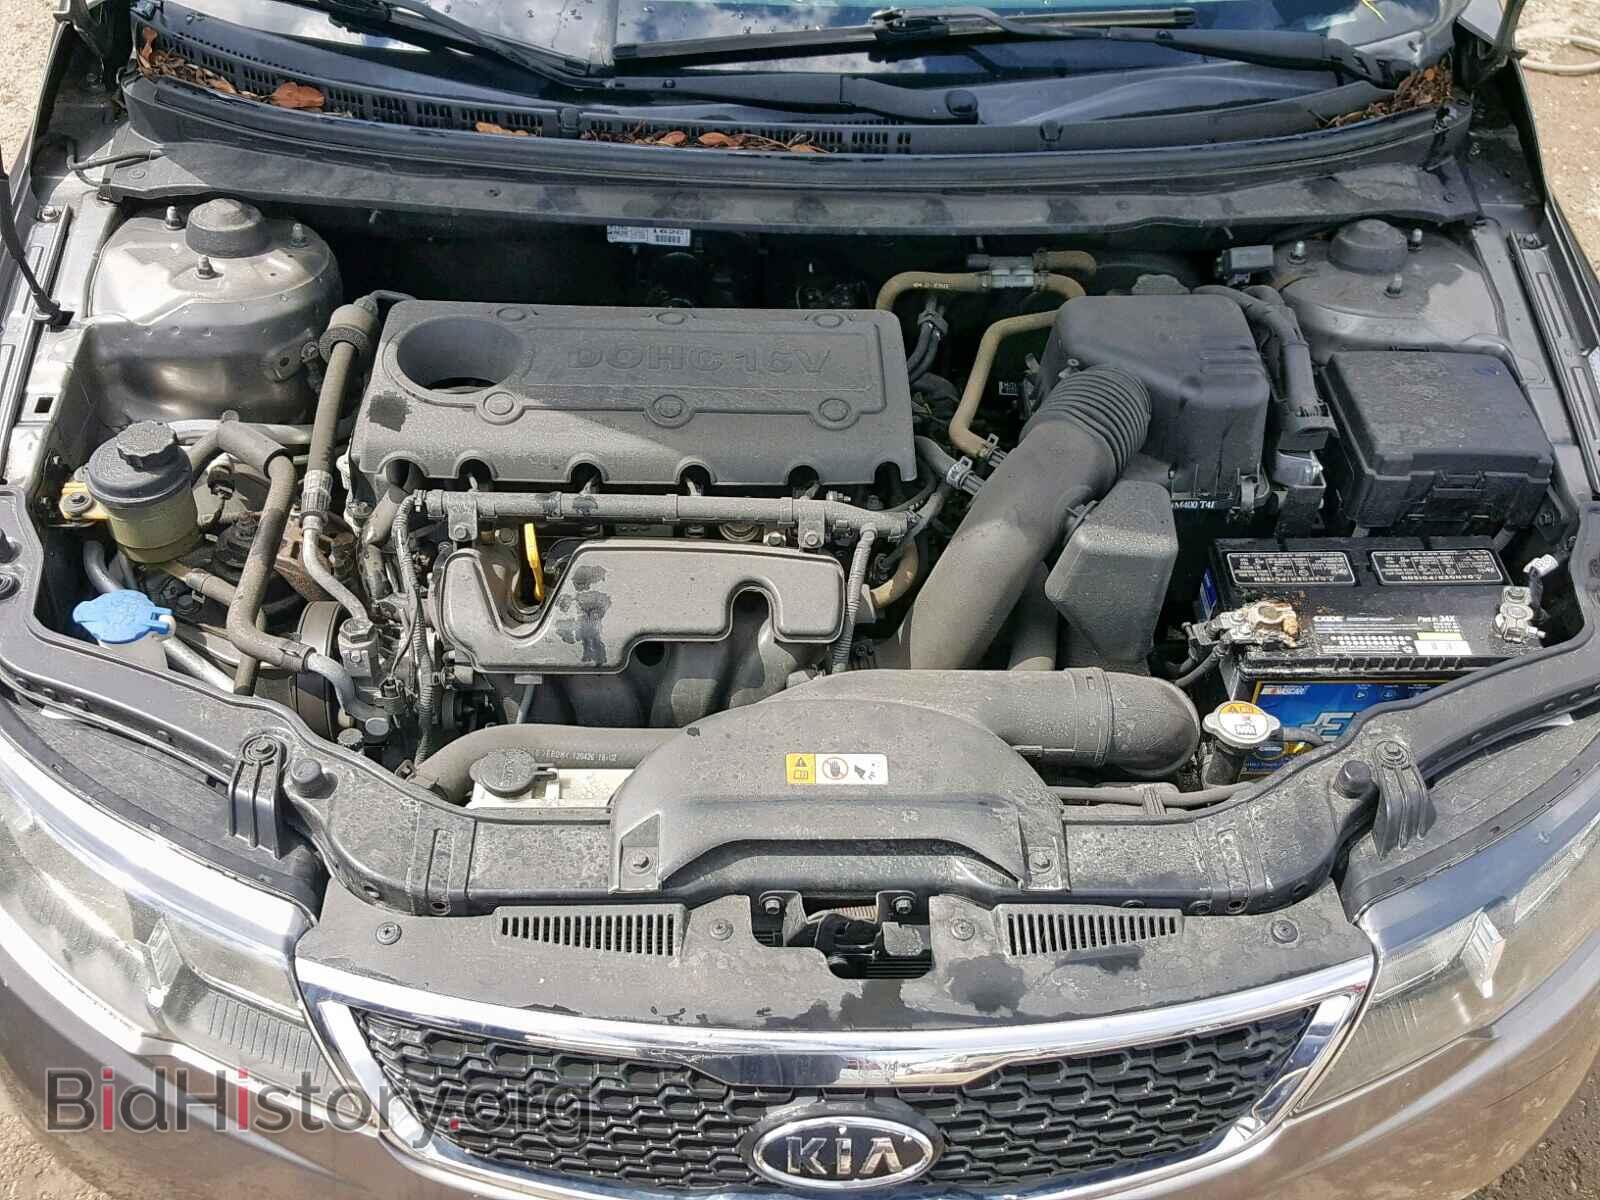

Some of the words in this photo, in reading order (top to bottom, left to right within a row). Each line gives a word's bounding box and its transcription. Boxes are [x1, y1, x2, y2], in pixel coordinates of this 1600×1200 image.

[567, 343, 723, 371] DOHC
[734, 345, 832, 374] 16V
[785, 1136, 904, 1175] KIA
